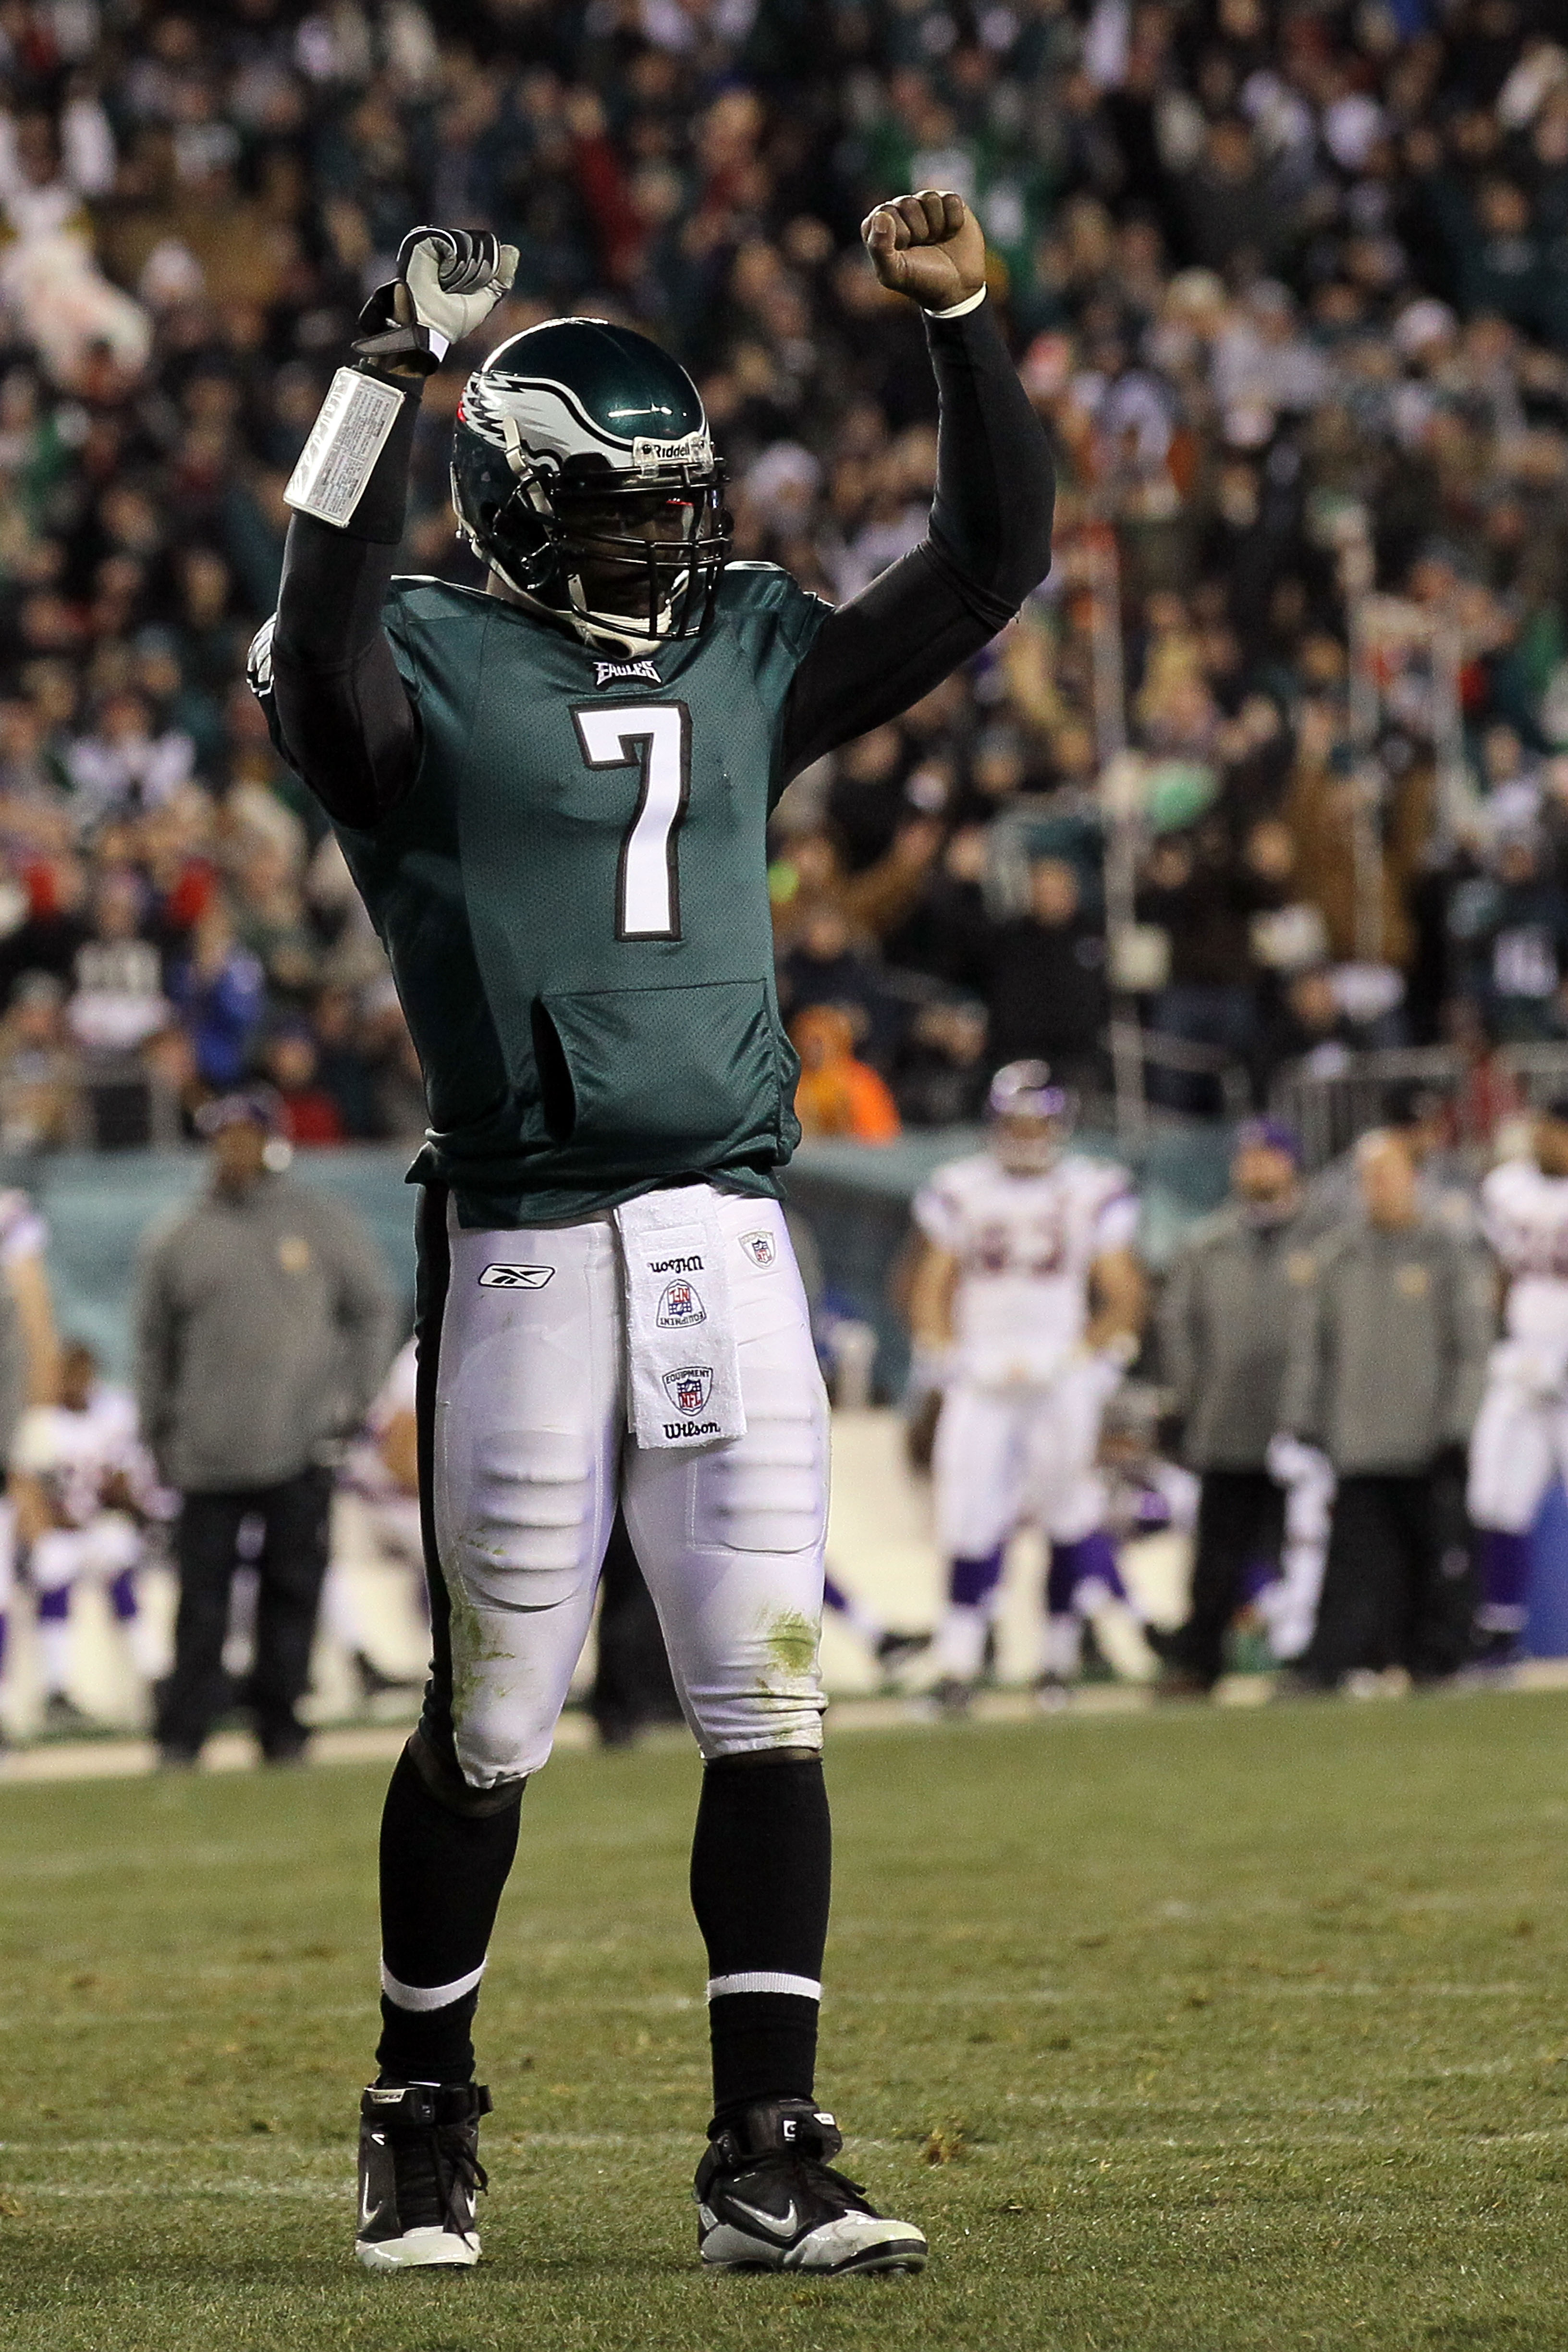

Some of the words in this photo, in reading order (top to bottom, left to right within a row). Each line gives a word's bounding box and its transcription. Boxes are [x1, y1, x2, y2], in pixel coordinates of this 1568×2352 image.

[593, 661, 662, 685] EAGLES
[570, 703, 692, 942] 7
[648, 1256, 704, 1274] Wilson
[669, 1287, 689, 1303] NFL
[660, 1311, 703, 1325] EQUIPMENT
[666, 1370, 709, 1384] EQUIPMENT
[679, 1393, 702, 1408] NFL
[663, 1421, 720, 1439] Wilson
